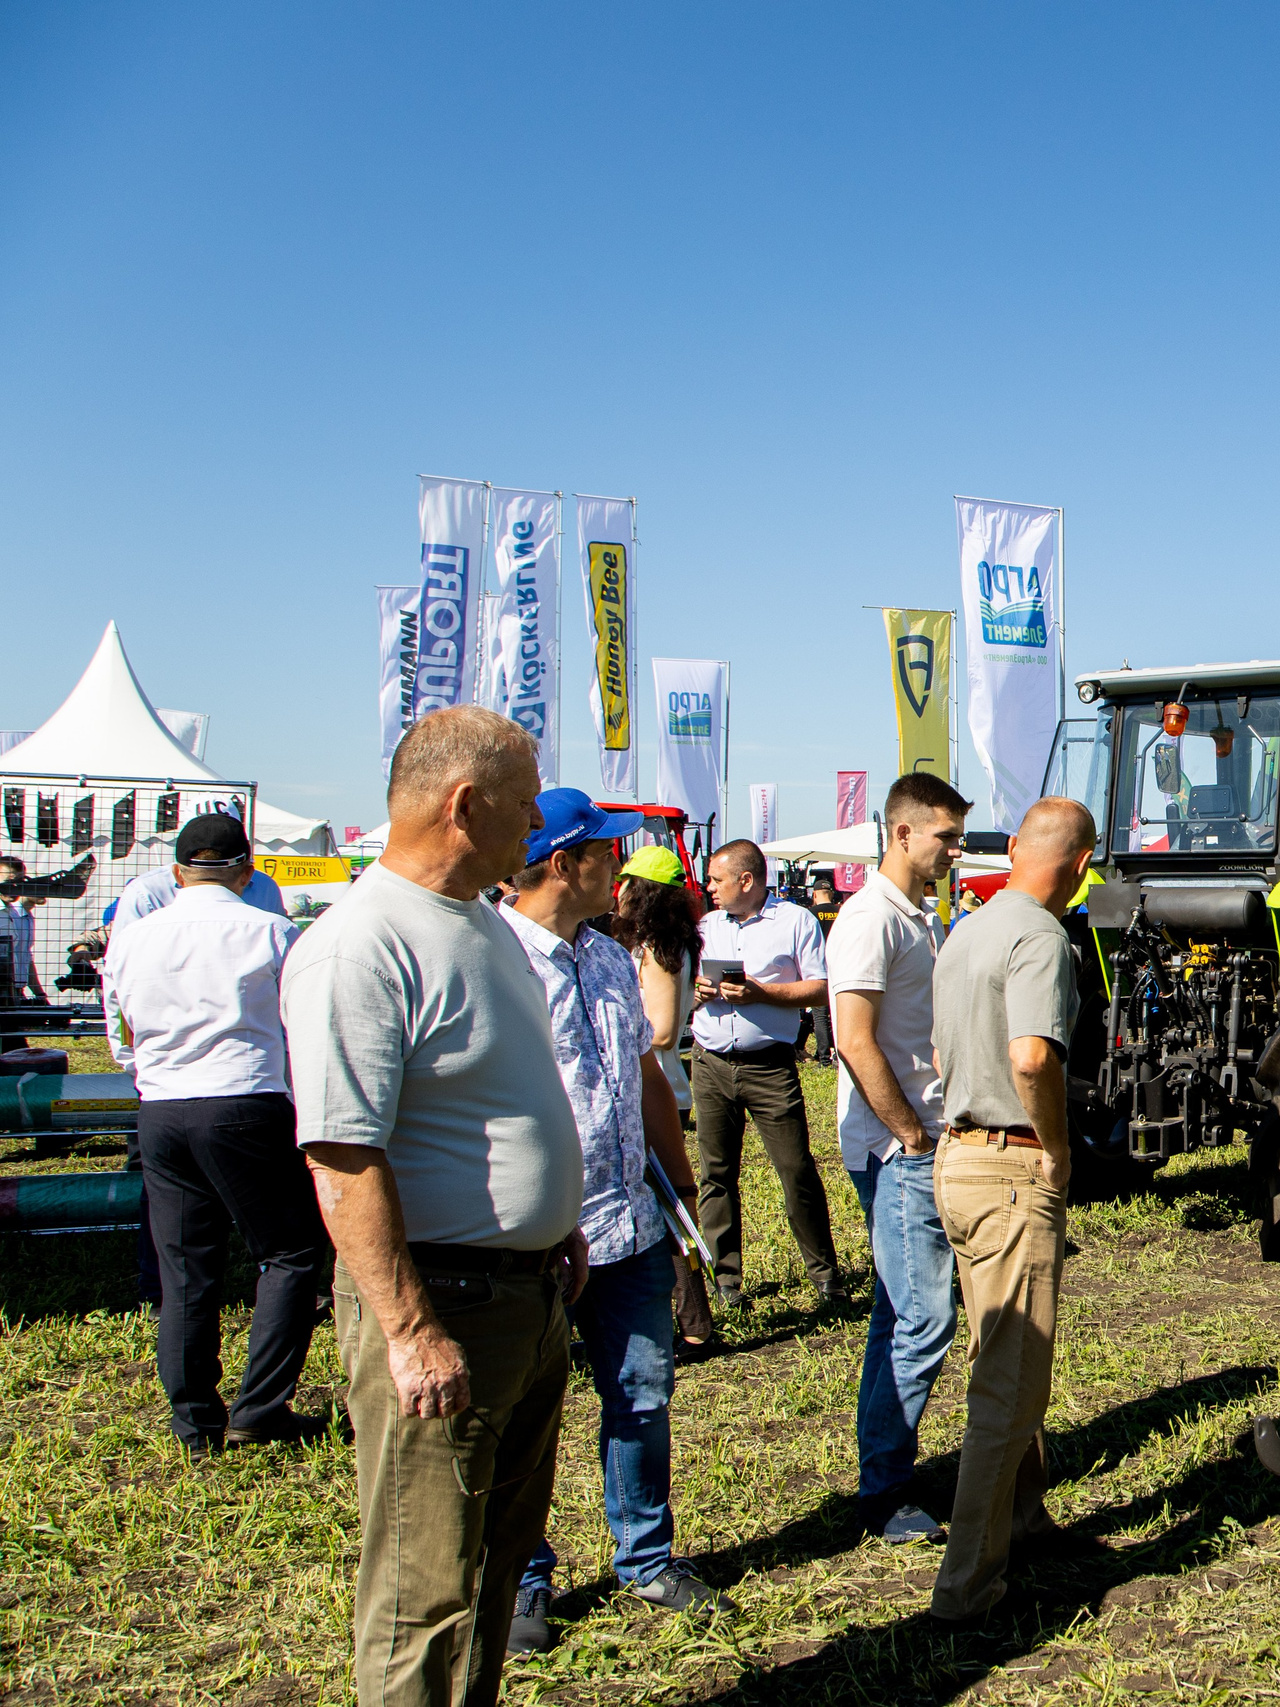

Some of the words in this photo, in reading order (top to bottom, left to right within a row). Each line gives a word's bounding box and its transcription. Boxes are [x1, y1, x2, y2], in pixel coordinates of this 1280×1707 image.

[600, 551, 620, 605] Bee
[287, 866, 327, 878] FJD.RU
[1218, 863, 1265, 872] ZOOMLION
